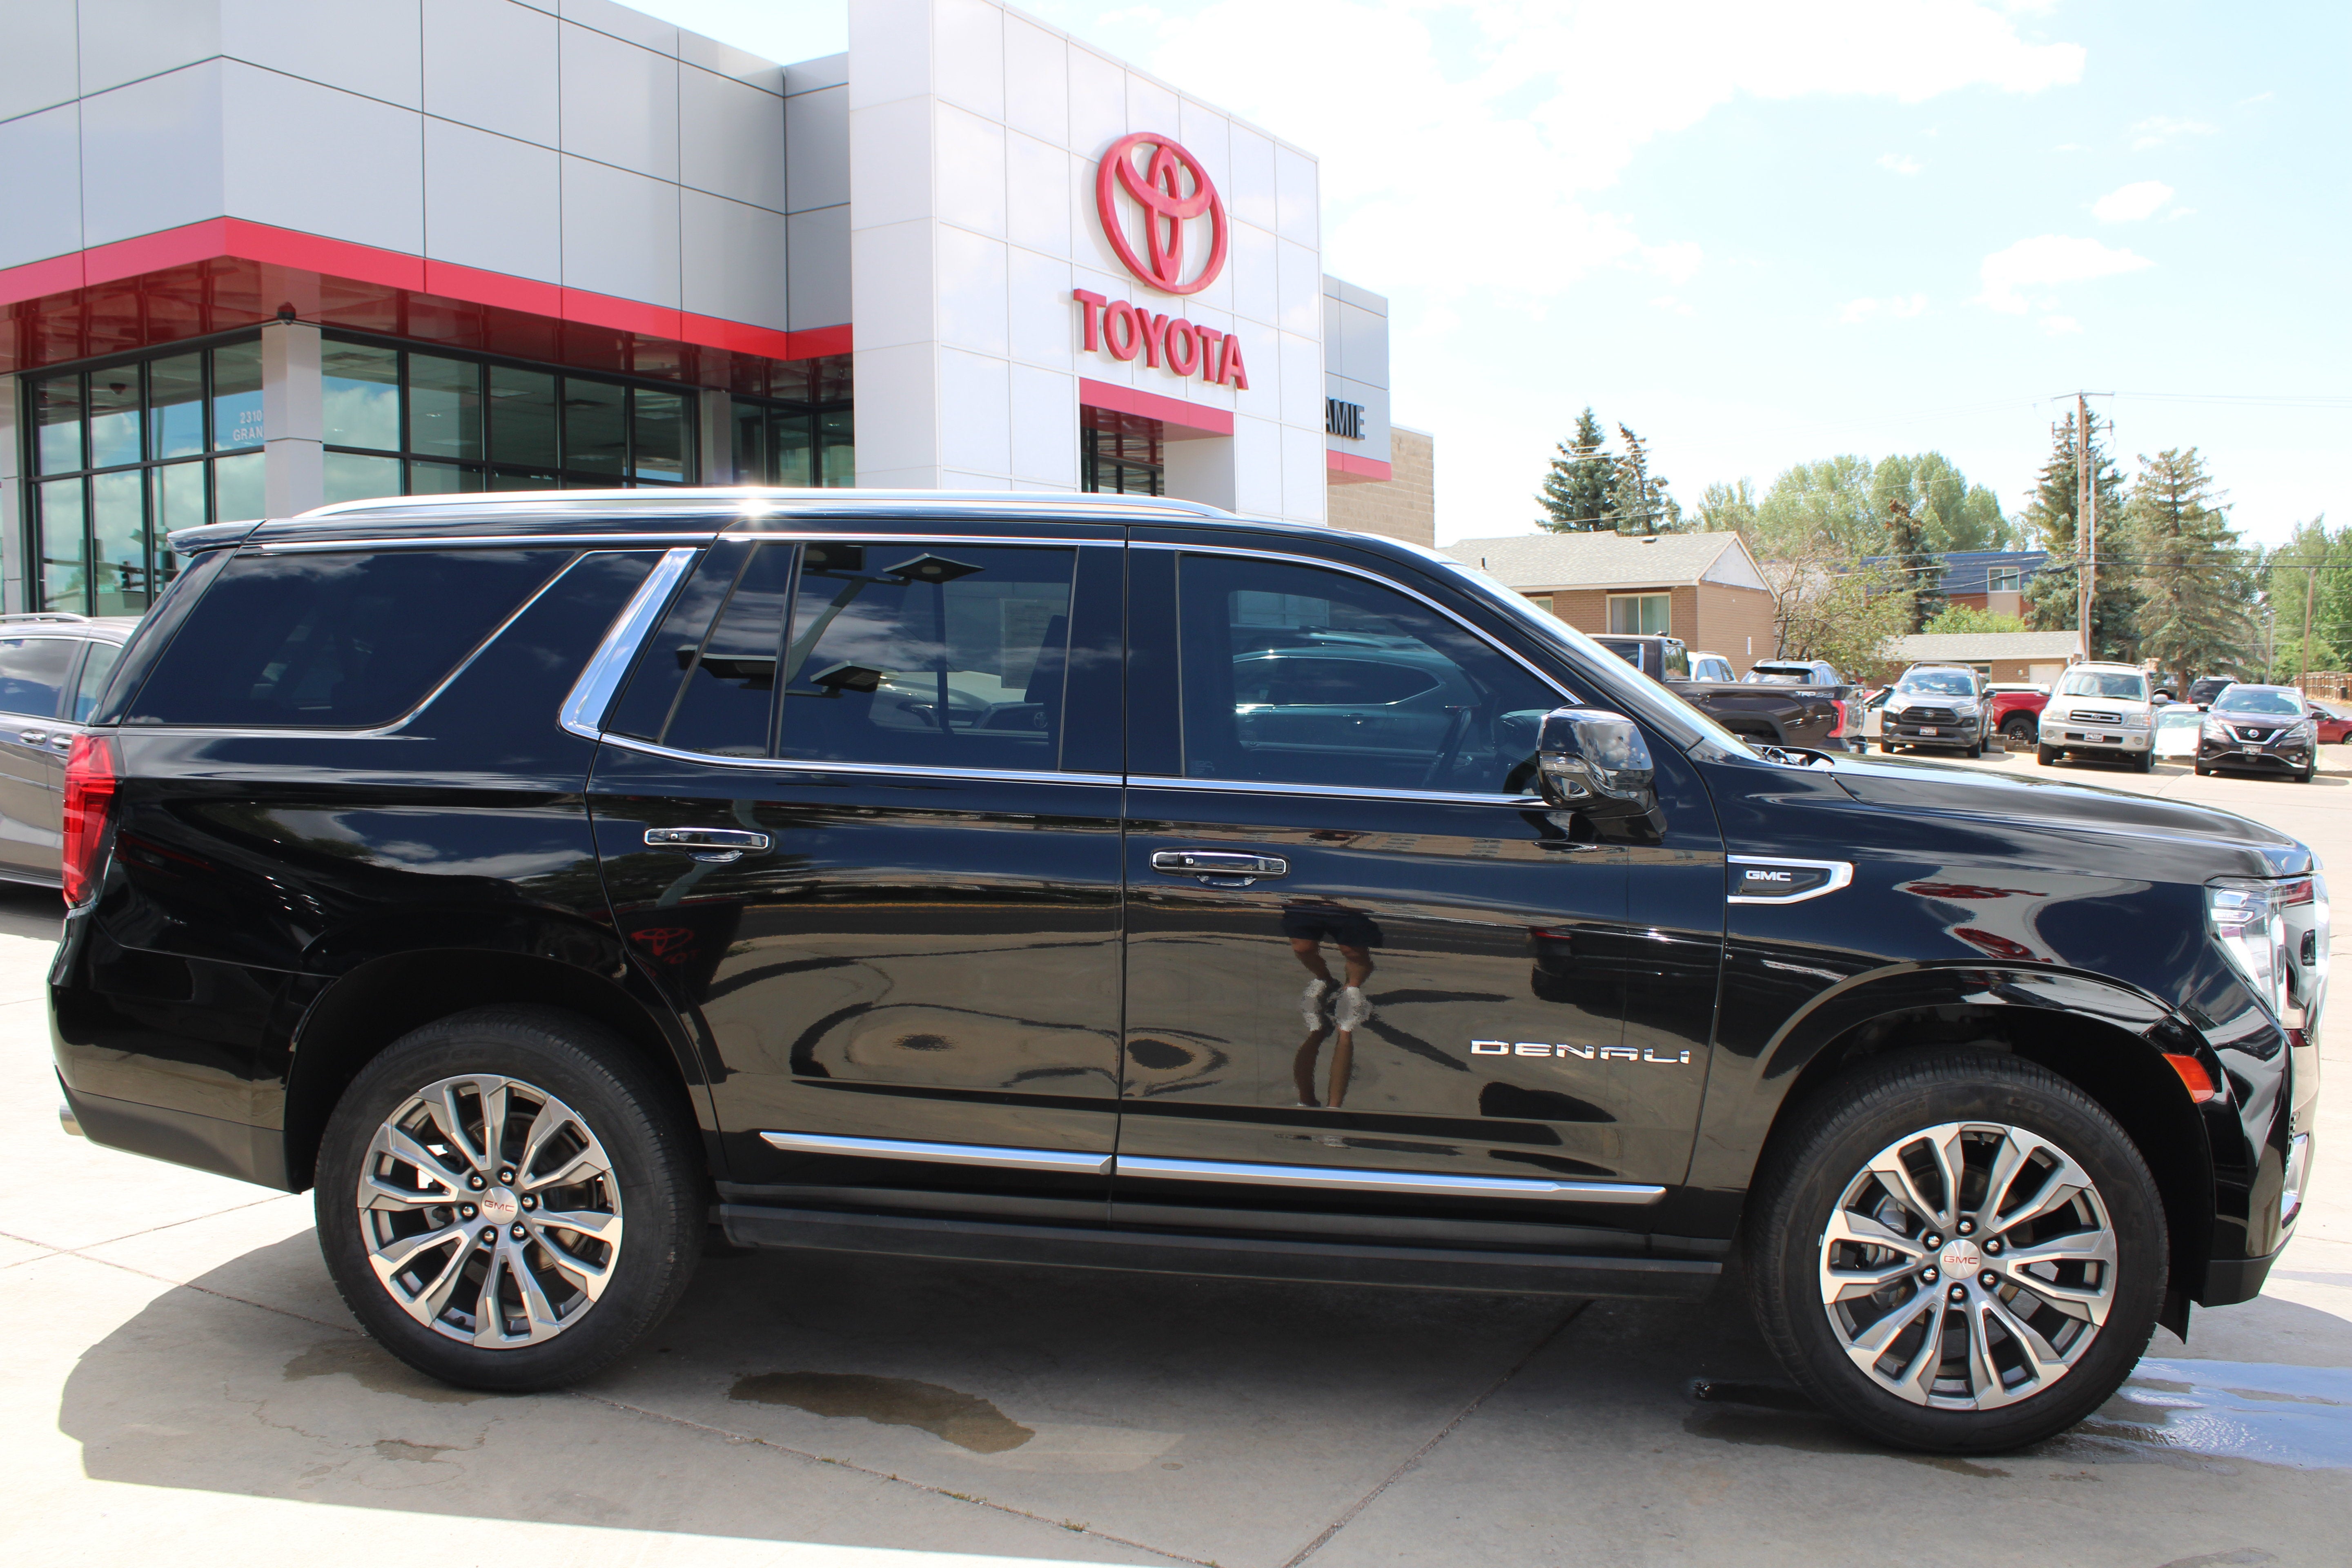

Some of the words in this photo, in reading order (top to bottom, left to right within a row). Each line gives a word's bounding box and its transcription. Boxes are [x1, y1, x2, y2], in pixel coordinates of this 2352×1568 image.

[1074, 288, 1249, 390] TOYOTA
[240, 410, 262, 423] 2310
[233, 426, 263, 441] GRAN
[1745, 870, 1791, 882] GMC
[1470, 1040, 1690, 1064] DENALI
[484, 1200, 514, 1212] GMC
[1944, 1255, 1978, 1265] GMC
